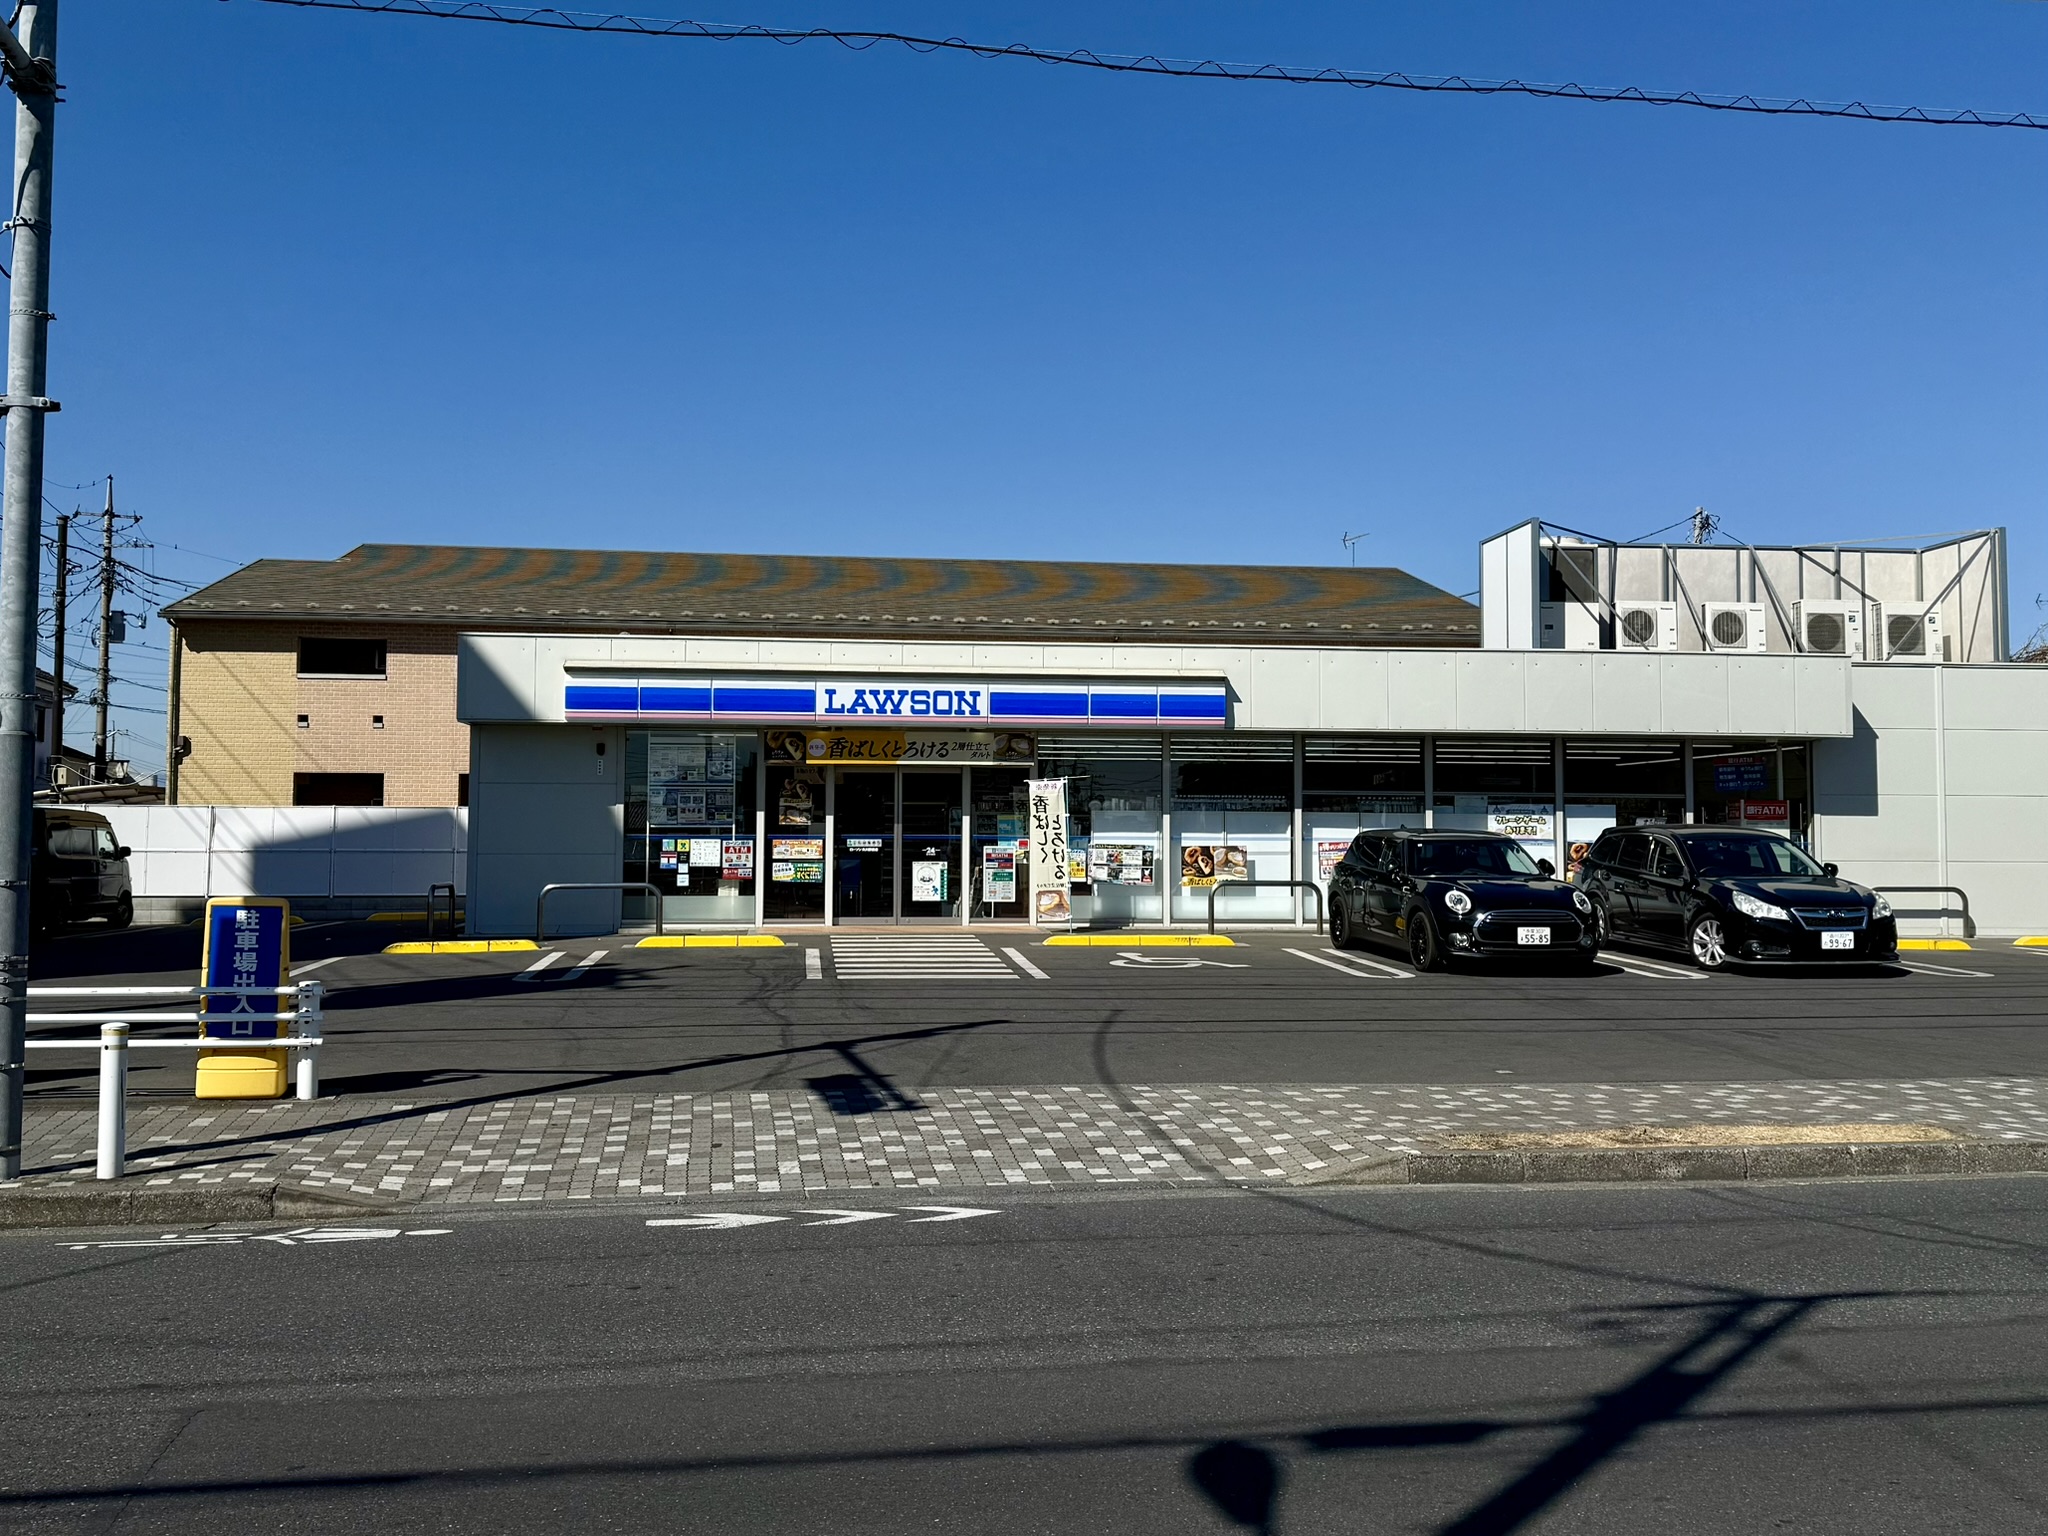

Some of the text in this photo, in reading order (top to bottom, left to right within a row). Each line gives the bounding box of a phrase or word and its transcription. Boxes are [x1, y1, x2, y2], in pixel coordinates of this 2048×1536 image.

[825, 689, 981, 716] LAWSON
[826, 736, 949, 759] 香ばしくとろける
[951, 741, 990, 751] 2層仕立て
[970, 751, 991, 759] タルト
[1746, 806, 1785, 815] 銀行ATM
[1495, 815, 1546, 825] クレーンゲーム
[728, 846, 748, 854] ATM
[1525, 934, 1549, 943] 55-85
[1829, 939, 1852, 947] 99-67
[231, 909, 260, 1036] 駐車場出入口
